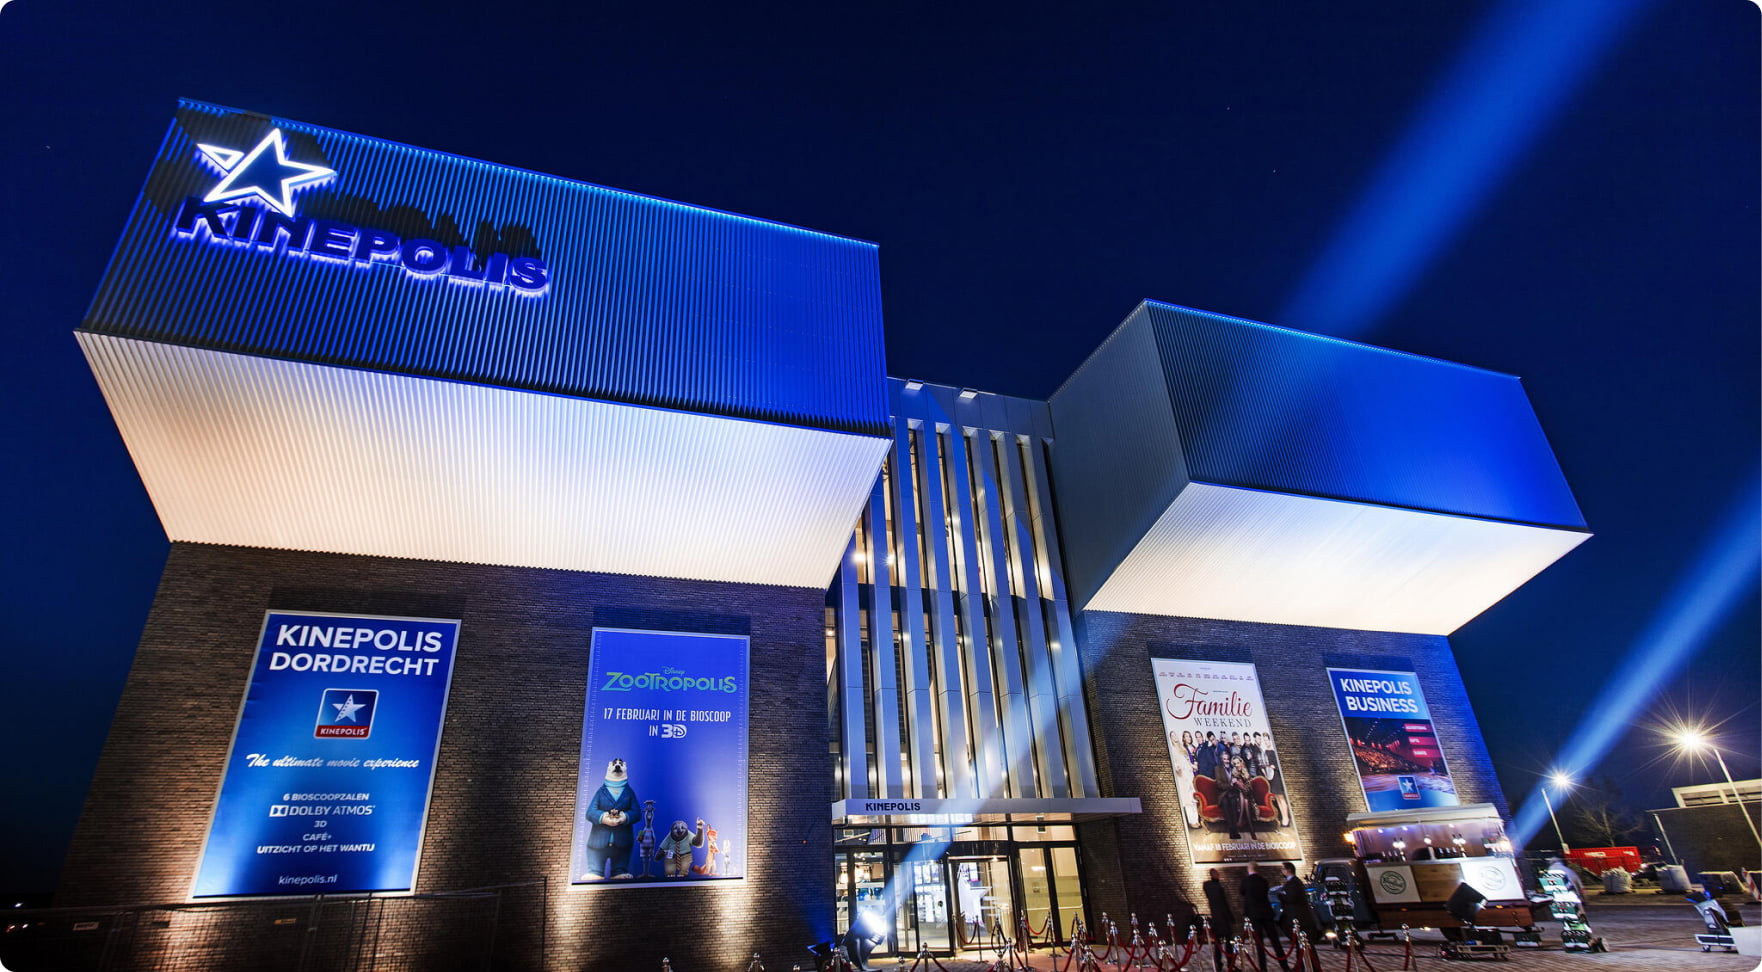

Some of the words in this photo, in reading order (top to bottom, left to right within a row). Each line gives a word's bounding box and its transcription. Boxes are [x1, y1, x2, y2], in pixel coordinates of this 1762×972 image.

[174, 199, 549, 296] KINEPOLIS
[276, 624, 442, 653] KINEPOLIS
[269, 652, 439, 676] DORDRECHT
[600, 672, 737, 693] ZOOTROPOLIS
[1340, 678, 1412, 695] KINEPOLIS
[1166, 683, 1252, 720] Familie
[1345, 696, 1419, 713] BUSINESS
[603, 708, 613, 720] 17
[616, 708, 660, 721] FEBRUARI
[663, 710, 673, 721] IN
[676, 710, 687, 721] DE
[690, 711, 731, 722] BIOSCOOP
[1194, 717, 1252, 728] WEEKEND
[320, 727, 367, 736] KINEPOLIS
[649, 725, 659, 737] IN
[661, 723, 687, 739] 3D
[245, 753, 270, 768] The
[272, 755, 323, 768] ultimate
[326, 757, 360, 768] movie
[363, 757, 420, 771] experience
[282, 793, 290, 801] 6
[291, 793, 370, 801] BIOSCOOPZALEN
[289, 805, 331, 816] DOLBY
[865, 802, 921, 811] KINEPOLIS
[313, 820, 327, 828] 3D
[257, 845, 302, 854] UITZICHT
[319, 845, 338, 853] HET
[1258, 842, 1266, 850] DE
[278, 874, 338, 886] kinepolis.nl
